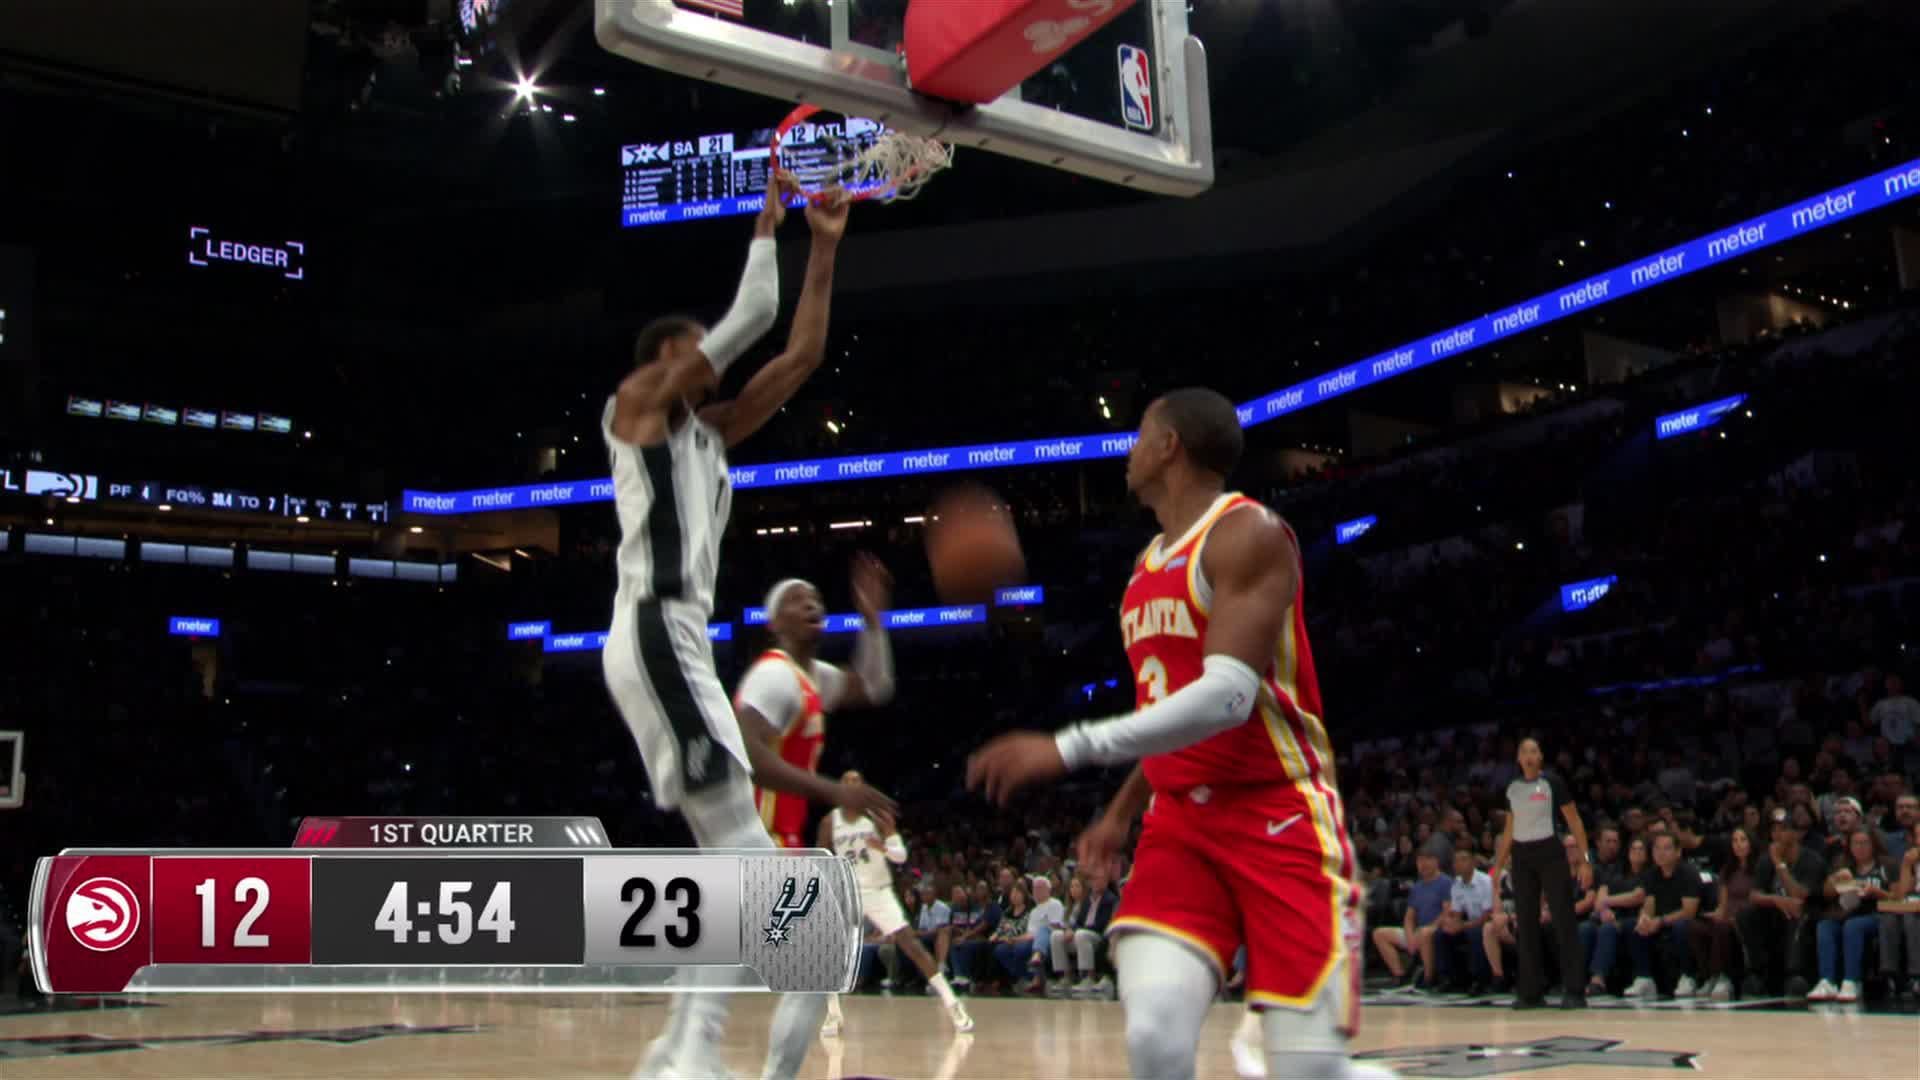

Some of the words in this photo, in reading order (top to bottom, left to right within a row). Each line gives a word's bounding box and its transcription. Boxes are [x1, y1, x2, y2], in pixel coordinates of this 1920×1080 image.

[792, 126, 806, 142] 12
[816, 122, 845, 139] ATL
[674, 141, 694, 156] SA
[709, 136, 724, 153] 21
[629, 208, 667, 224] meter
[683, 202, 722, 217] meter
[737, 197, 764, 212] met
[206, 239, 289, 268] LEDGER
[413, 495, 456, 510] meter
[473, 491, 515, 506] meter
[531, 486, 573, 501] meter
[728, 469, 756, 485] eter
[775, 464, 821, 481] meter
[838, 458, 885, 475] meter
[903, 452, 949, 470] meter
[968, 447, 1016, 464] meter
[1034, 441, 1083, 458] meter
[1102, 435, 1136, 453] met
[1236, 405, 1254, 422] ter
[1267, 389, 1304, 413] meter
[1318, 369, 1357, 396] meter
[1372, 348, 1415, 377] meter
[1431, 325, 1476, 356] meter
[1493, 303, 1541, 335] meter
[1559, 278, 1610, 310] meter
[1631, 250, 1685, 285] meter
[1708, 221, 1767, 258] meter
[1791, 189, 1857, 229] meter
[1661, 411, 1699, 433] meter
[109, 484, 131, 498] PF
[240, 496, 260, 509] TO
[1002, 589, 1036, 602] meter
[177, 620, 213, 633] meter
[892, 611, 925, 625] meter
[940, 607, 973, 622] meter
[1121, 598, 1198, 650] TLANTA
[514, 624, 544, 637] meter
[554, 635, 584, 649] meter
[1138, 655, 1168, 706] 3
